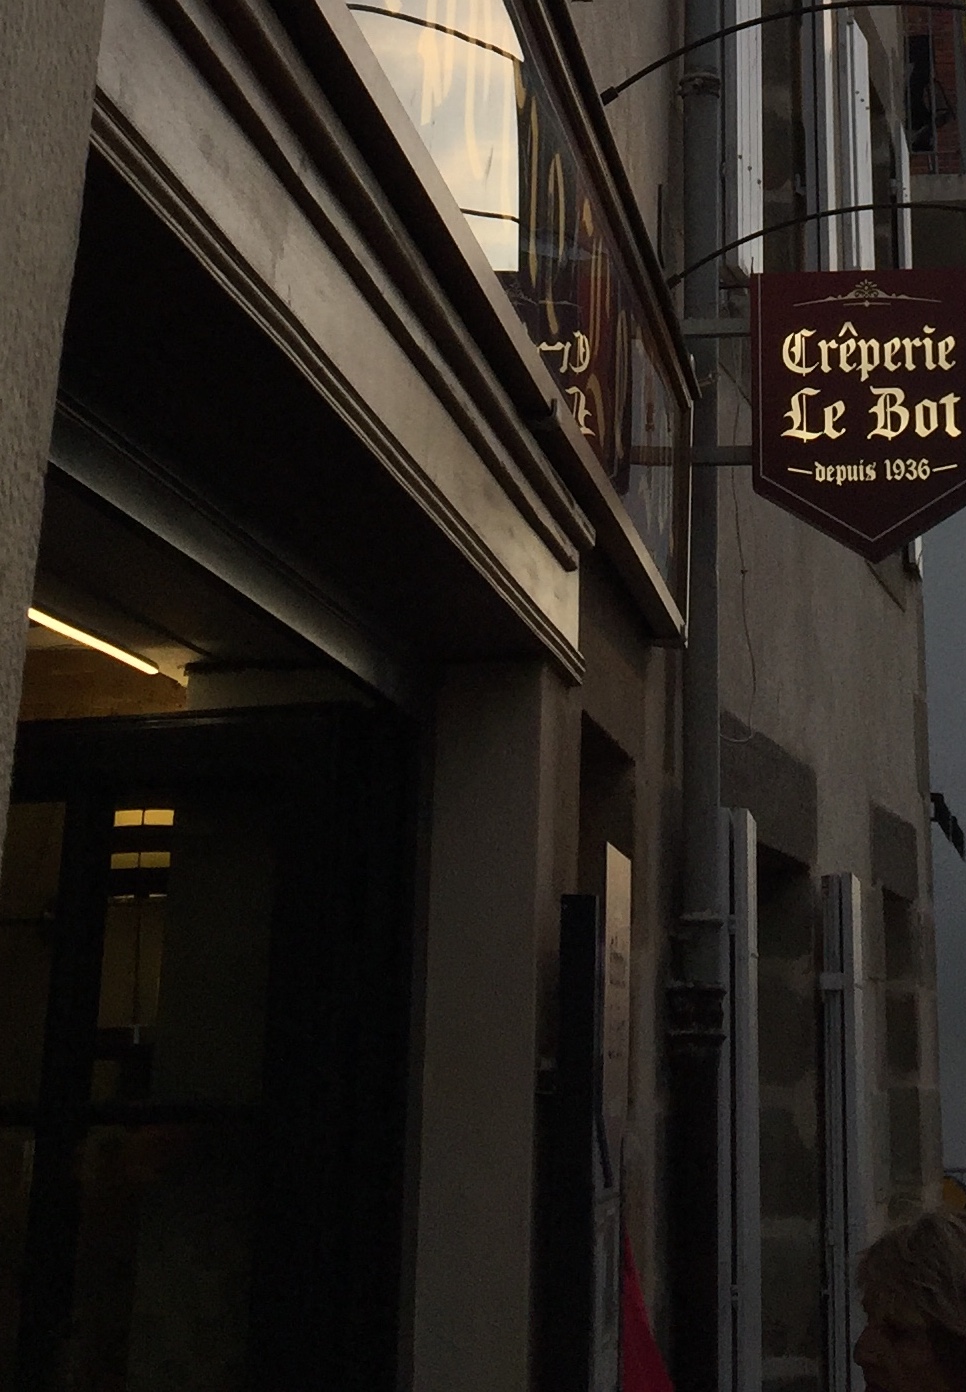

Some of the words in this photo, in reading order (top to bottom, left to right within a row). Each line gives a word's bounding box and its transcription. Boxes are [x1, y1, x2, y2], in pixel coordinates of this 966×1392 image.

[782, 321, 957, 382] Crêperie
[780, 386, 847, 443] Le
[866, 385, 962, 441] Bot
[814, 460, 877, 486] depuis
[884, 458, 931, 481] 1936
